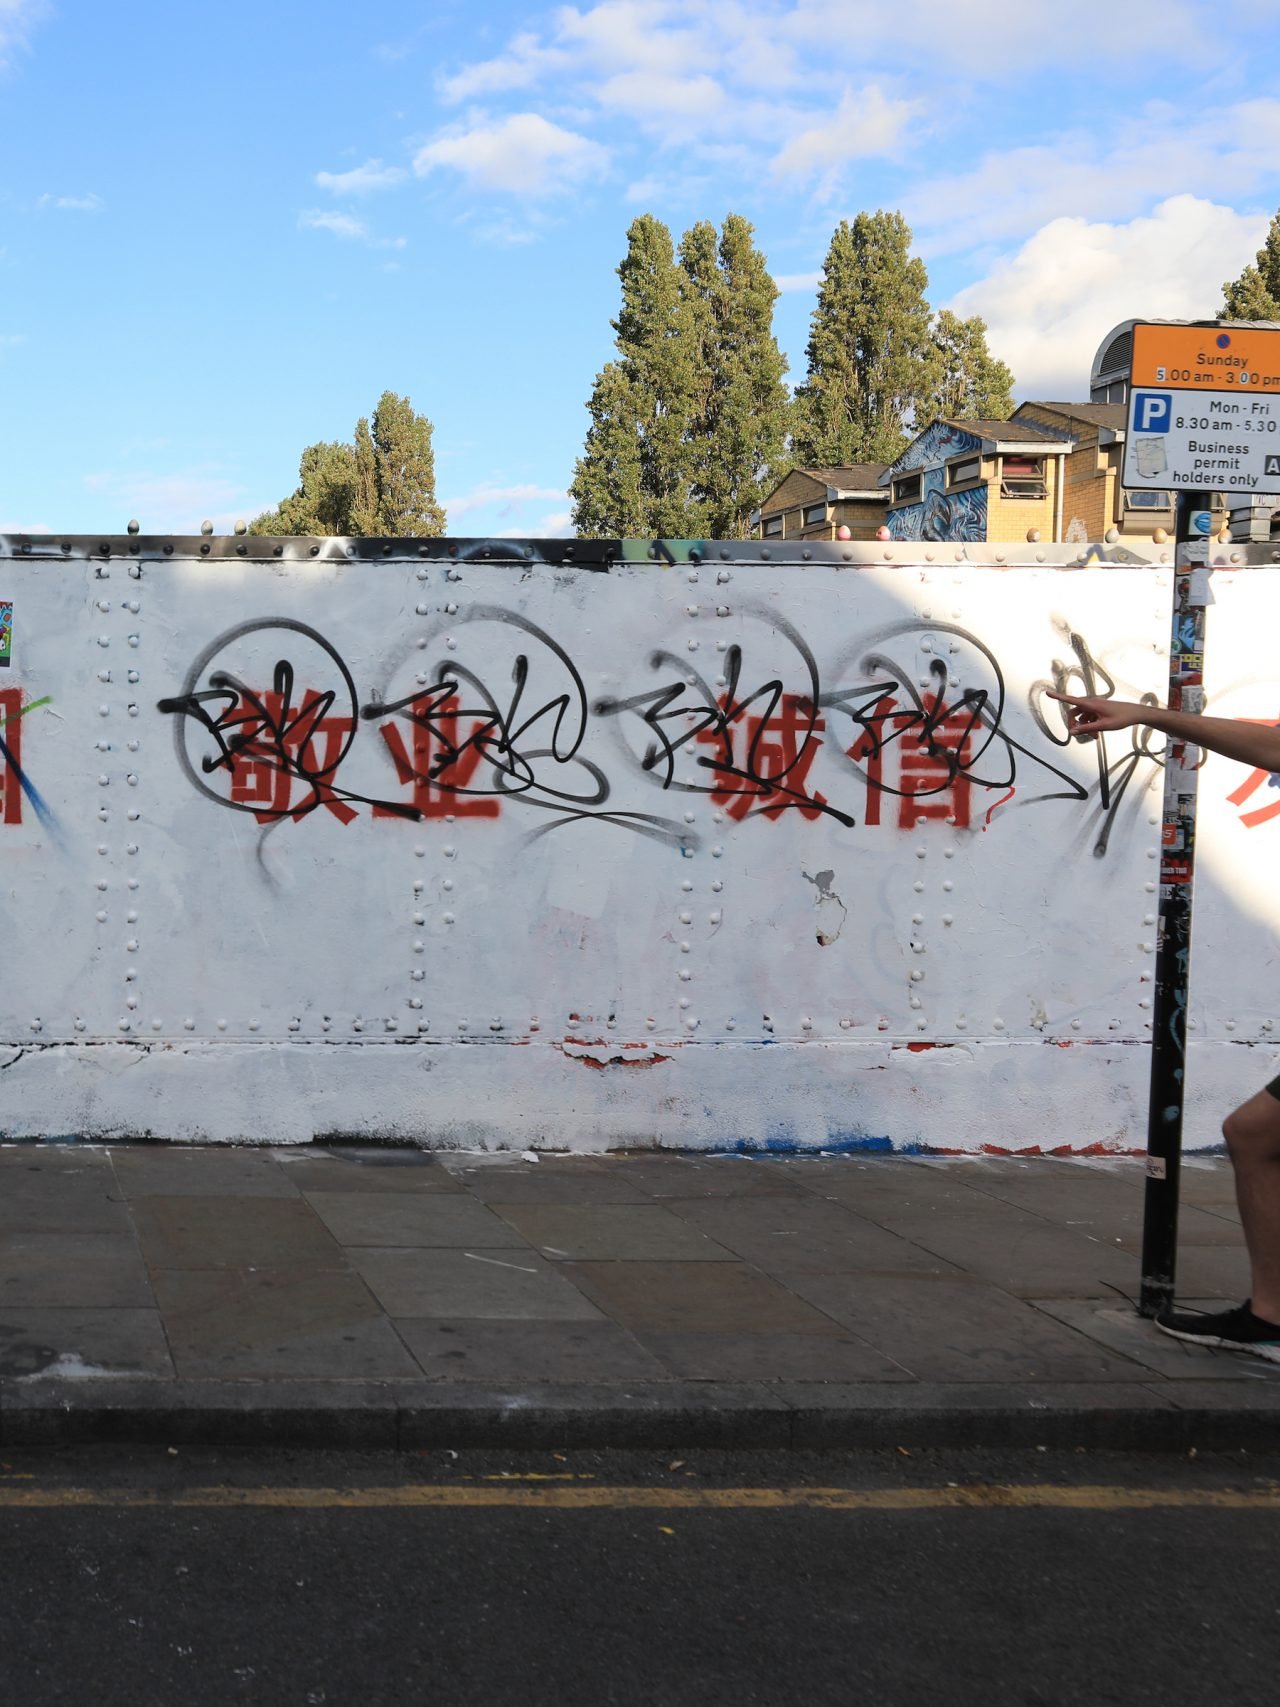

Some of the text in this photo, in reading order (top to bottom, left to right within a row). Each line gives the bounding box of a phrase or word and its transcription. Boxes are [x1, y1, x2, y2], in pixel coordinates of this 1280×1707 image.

[1196, 353, 1248, 369] Sunday
[1156, 368, 1191, 381] 5.00
[1194, 372, 1214, 383] am
[1226, 371, 1259, 385] 3.00
[1141, 397, 1167, 429] P
[1209, 401, 1239, 414] Mon
[1251, 403, 1270, 415] Fri
[1175, 417, 1209, 430] 8.30
[1212, 420, 1232, 431] am
[1244, 420, 1277, 433] 5.30
[1188, 441, 1250, 455] Business
[1194, 457, 1240, 470] permit
[1173, 471, 1259, 488] holders only
